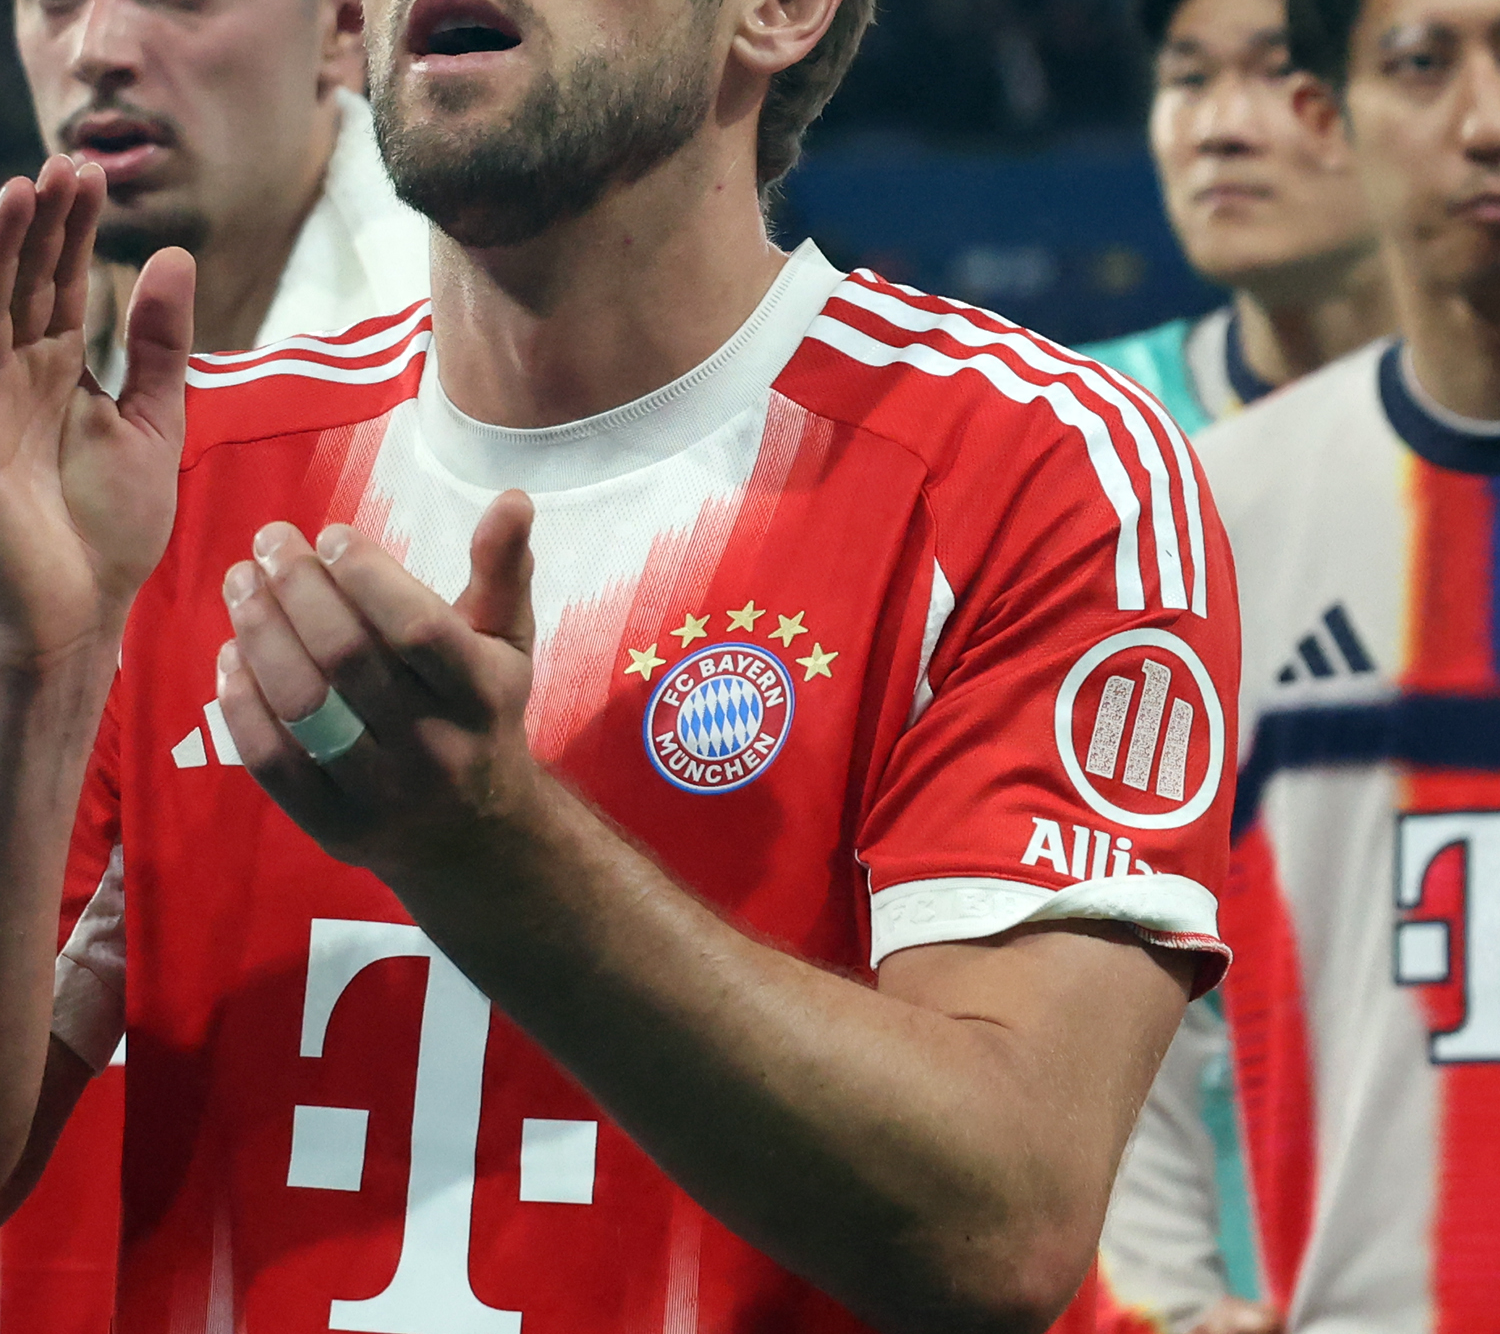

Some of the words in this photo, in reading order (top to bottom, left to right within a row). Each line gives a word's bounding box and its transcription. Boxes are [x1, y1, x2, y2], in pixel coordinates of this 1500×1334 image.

[662, 674, 694, 707] FC
[698, 654, 785, 708] BAYERN
[655, 730, 776, 784] MÜNCHEN
[1020, 816, 1164, 881] Alli
